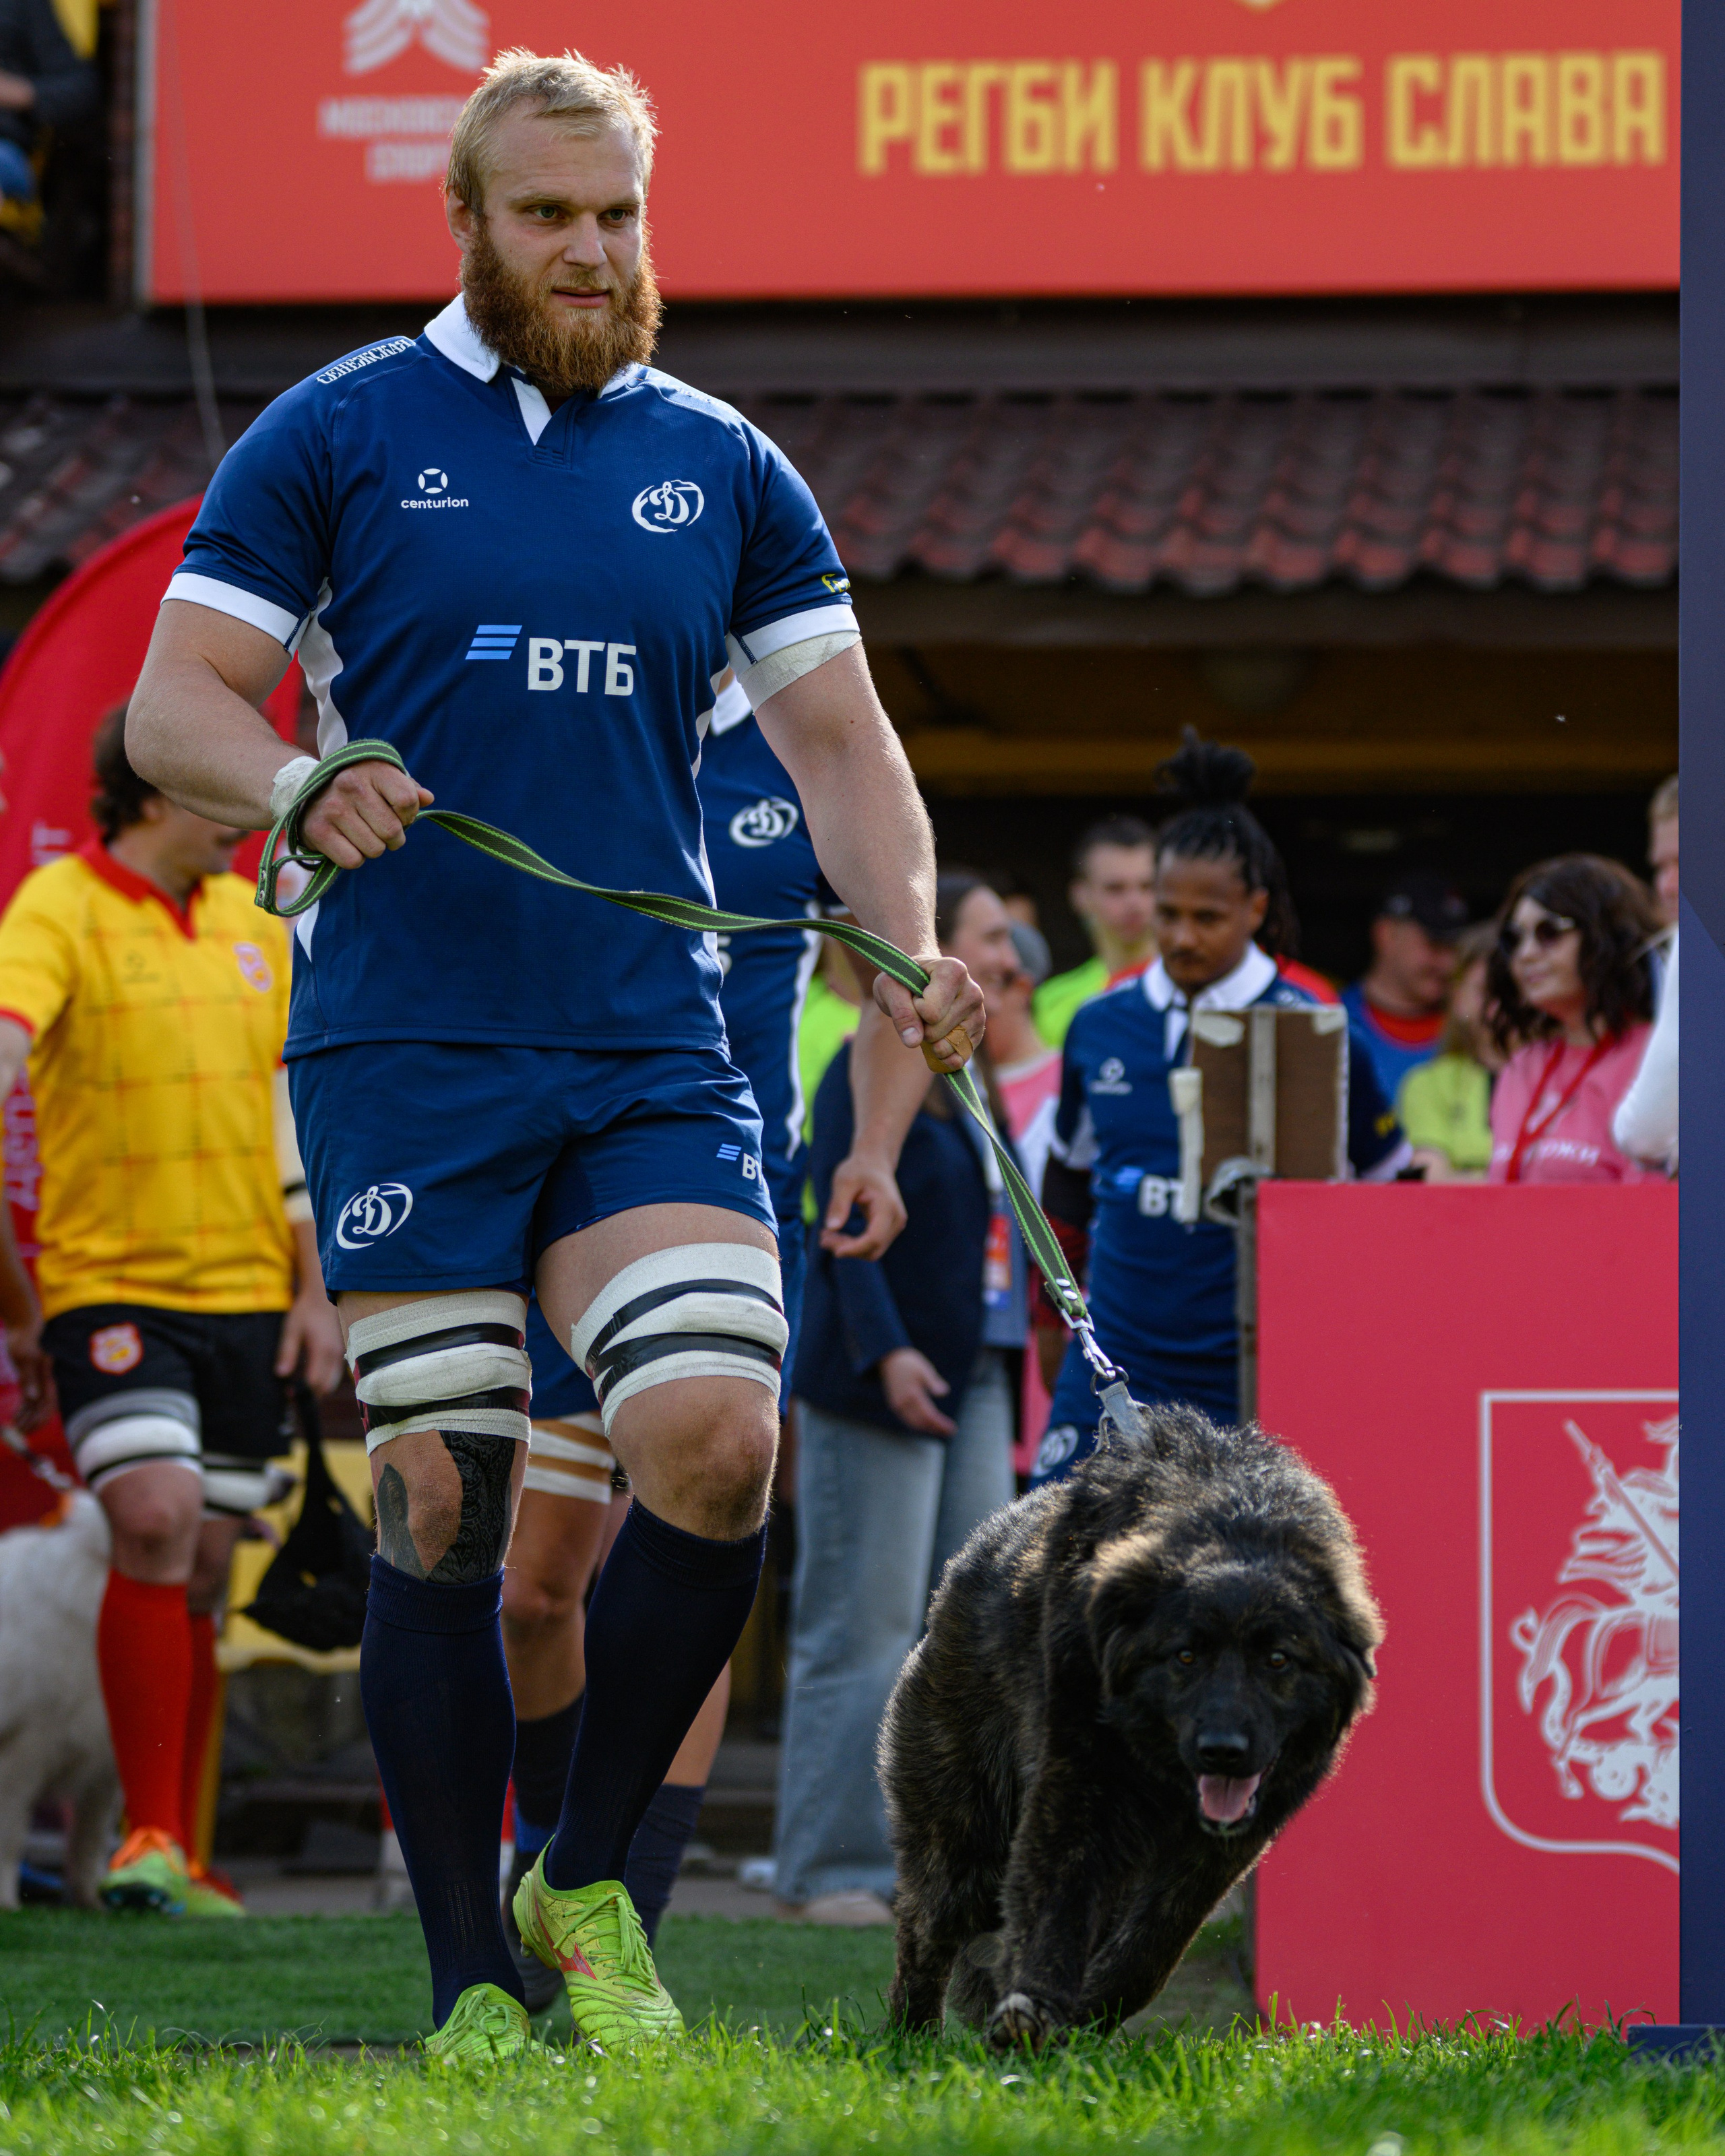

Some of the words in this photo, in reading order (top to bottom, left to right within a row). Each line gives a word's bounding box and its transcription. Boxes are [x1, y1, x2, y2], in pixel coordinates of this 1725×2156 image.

[857, 61, 1117, 175] РЕГБИ
[1140, 57, 1362, 171] КЛУБ
[1385, 51, 1666, 168] СЛАВА
[316, 339, 416, 384] СЕНЕЖСКАЯ
[401, 497, 469, 509] centurion
[528, 637, 637, 696] ВТБ
